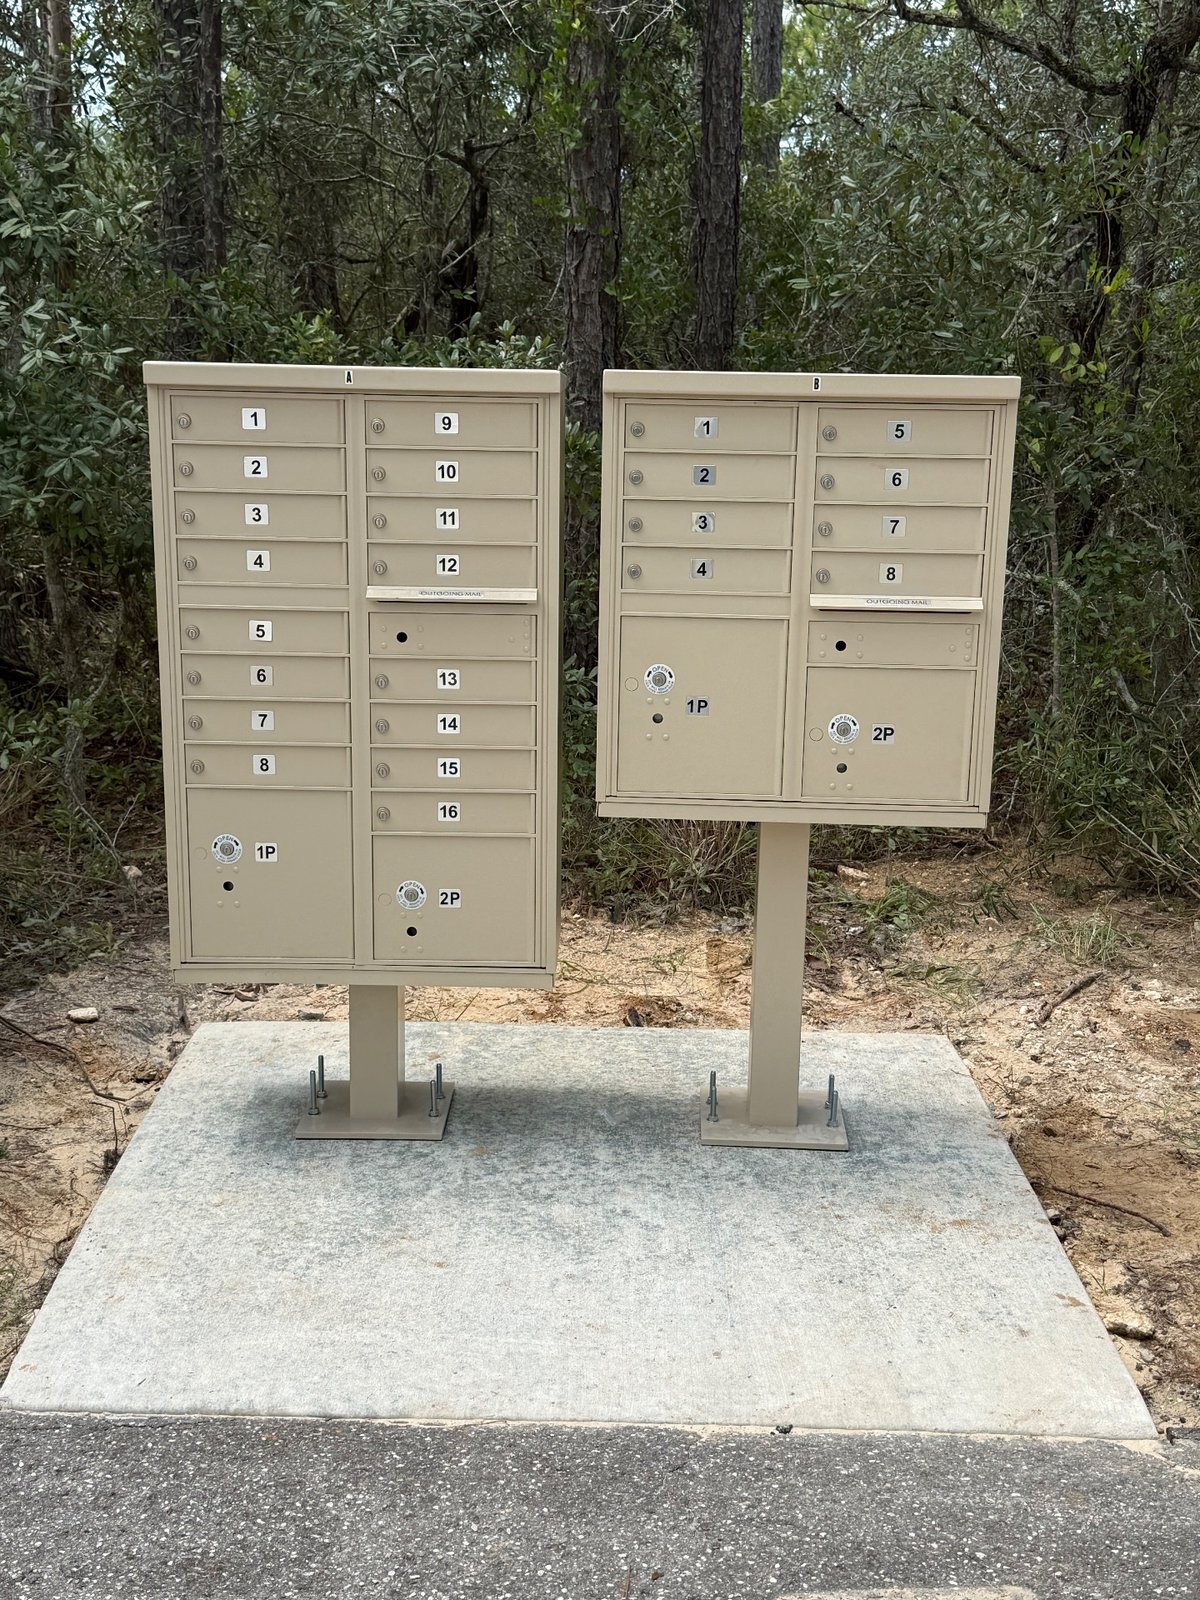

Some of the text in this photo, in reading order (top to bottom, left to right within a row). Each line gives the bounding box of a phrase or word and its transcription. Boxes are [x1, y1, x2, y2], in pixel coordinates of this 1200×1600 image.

[346, 370, 352, 384] A
[813, 377, 820, 390] B
[250, 411, 258, 427] 1
[441, 416, 452, 431] 9
[702, 420, 710, 435] 1
[894, 423, 905, 439] 5
[251, 459, 262, 475] 2
[437, 464, 457, 479] 10
[699, 467, 710, 483] 2
[891, 472, 902, 487] 6
[251, 507, 262, 523] 3
[439, 511, 455, 526] 11
[698, 515, 708, 530] 3
[889, 519, 900, 535] 7
[253, 554, 264, 569] 4
[438, 557, 458, 573] 12
[696, 561, 707, 577] 4
[886, 566, 896, 581] 8
[255, 624, 266, 639] 5
[256, 668, 267, 683] 6
[651, 665, 668, 673] OPEN
[439, 672, 458, 686] 13
[687, 699, 709, 714] 1P
[258, 713, 268, 728] 7
[439, 716, 458, 731] 14
[835, 716, 852, 724] OPEN
[872, 727, 895, 741] 2P
[259, 757, 269, 772] 8
[440, 761, 458, 775] 15
[439, 804, 458, 819] 16
[217, 835, 234, 843] OPEN
[256, 845, 276, 860] 1P
[403, 881, 420, 889] OPEN
[440, 891, 460, 905] 2P
